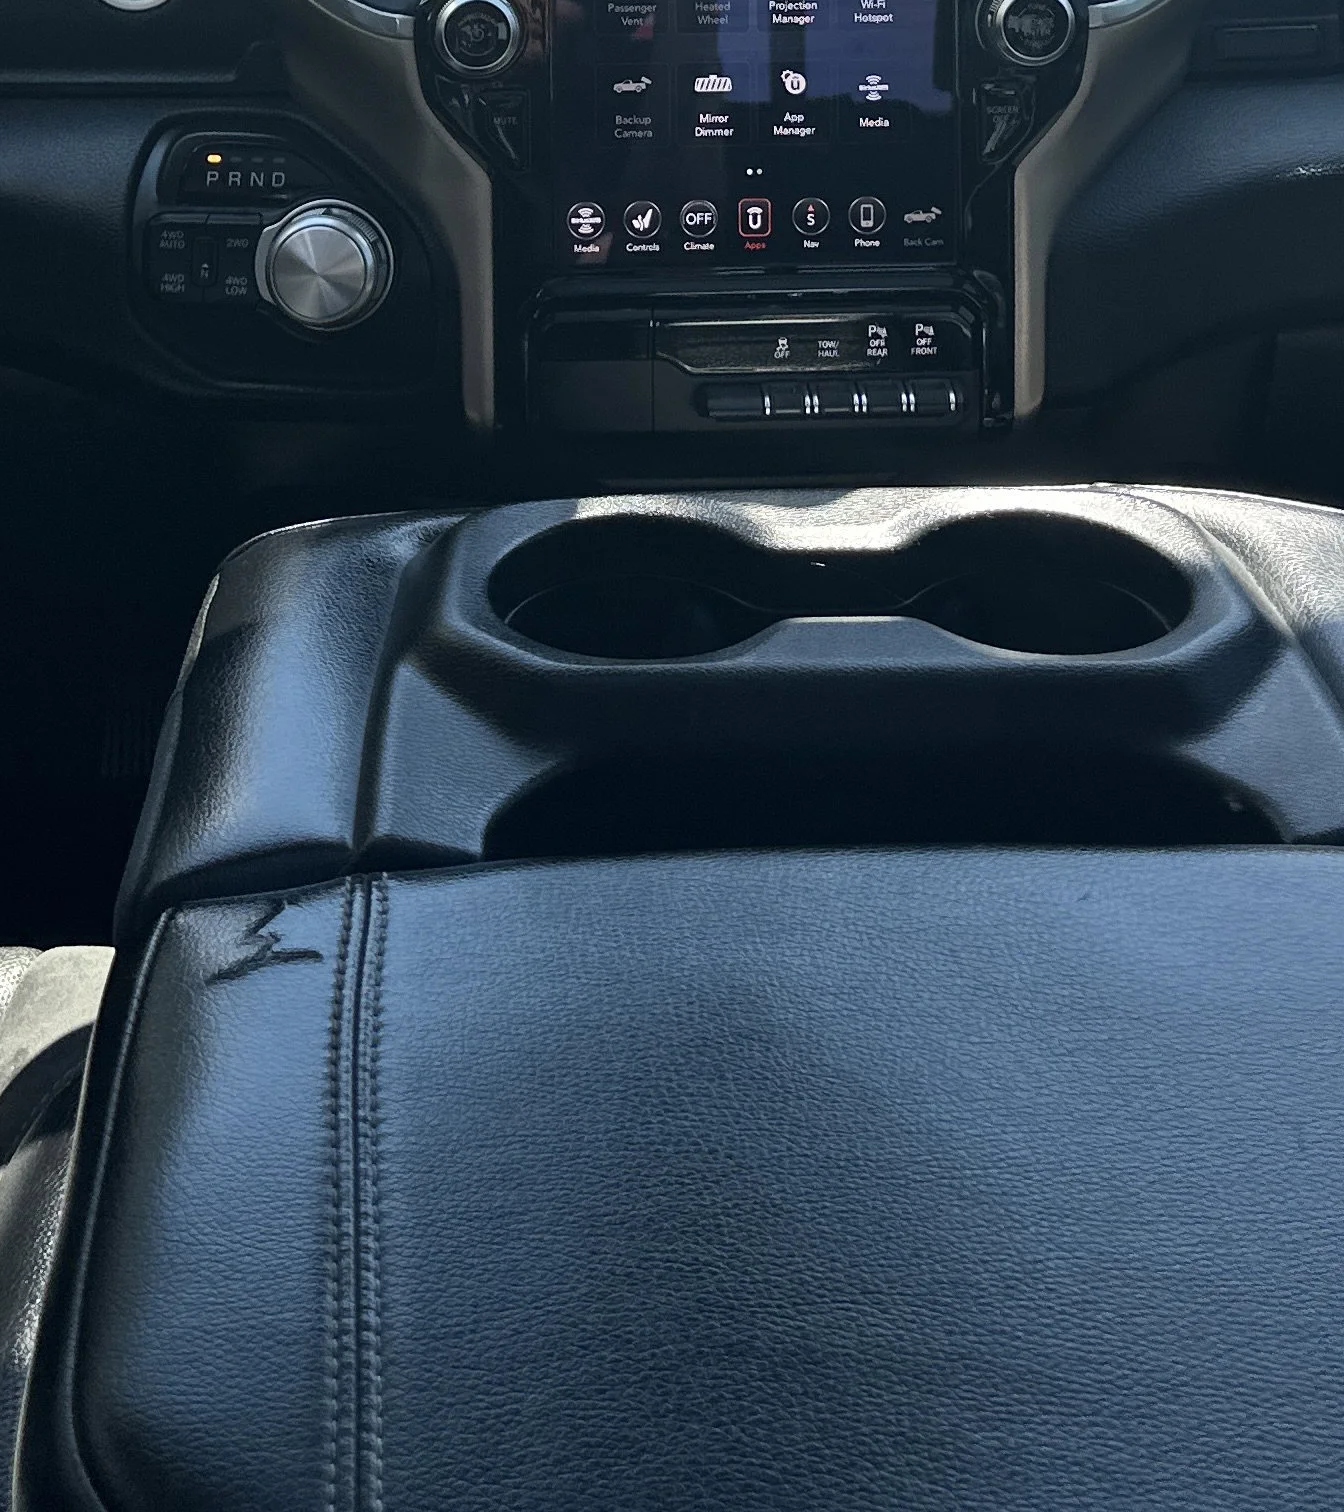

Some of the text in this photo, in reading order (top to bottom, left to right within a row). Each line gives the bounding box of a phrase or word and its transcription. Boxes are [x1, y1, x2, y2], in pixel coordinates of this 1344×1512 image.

[607, 2, 657, 14] Passenger
[695, 1, 731, 12] Heated
[768, 0, 818, 12] Projection
[620, 16, 644, 26] Vent
[697, 14, 729, 25] Wheel
[772, 13, 815, 25] Manager
[854, 12, 894, 24] Hotspot
[615, 114, 652, 126] Backup
[699, 113, 729, 124] Mirror
[783, 112, 805, 124] App
[859, 117, 890, 128] Media
[614, 128, 653, 139] Camera
[694, 126, 735, 137] Dimmer
[773, 125, 816, 137] Manager
[206, 171, 286, 188] P R N D
[685, 213, 713, 226] OFF
[806, 213, 816, 226] S
[573, 244, 600, 253] Media
[625, 242, 660, 252] Controls
[683, 241, 715, 251] Climate
[744, 240, 767, 250] Apps
[803, 239, 820, 248] Nav
[854, 238, 881, 248] Phone
[869, 339, 886, 348] OFF
[916, 338, 932, 346] OFF
[774, 350, 791, 359] OFF
[817, 349, 840, 358] HAUL
[866, 347, 888, 357] REAR
[910, 346, 938, 356] FRONT
